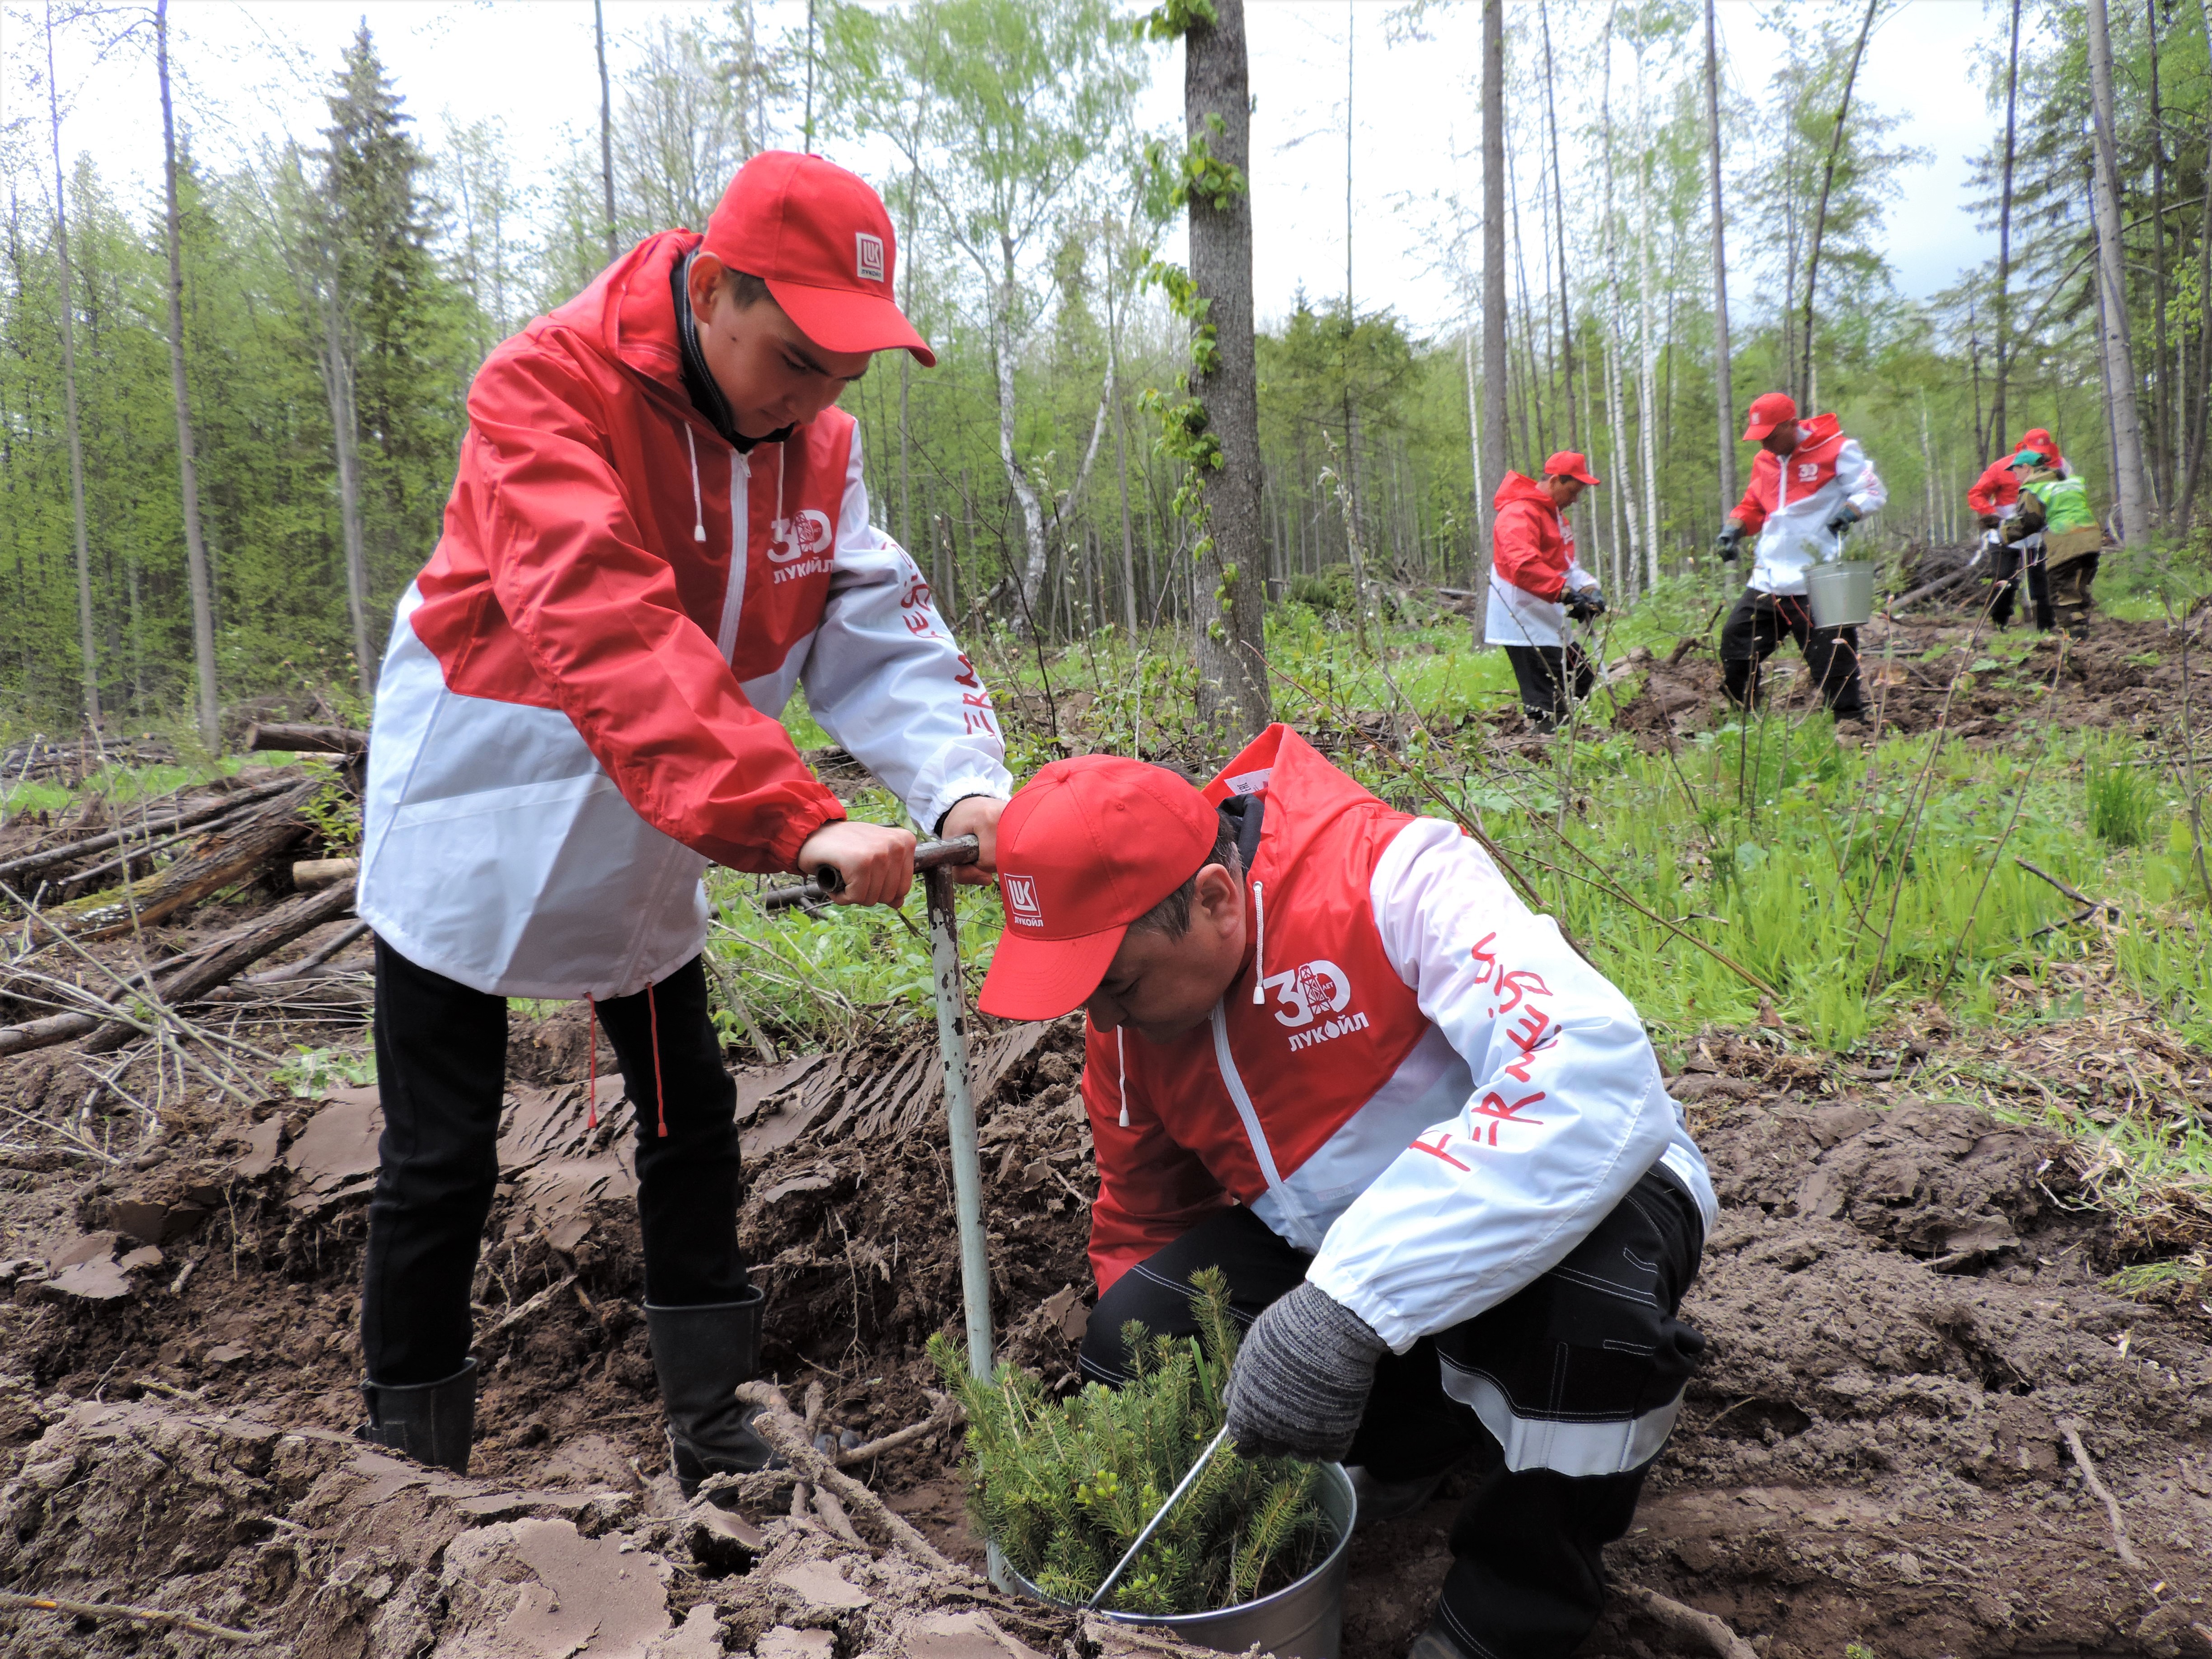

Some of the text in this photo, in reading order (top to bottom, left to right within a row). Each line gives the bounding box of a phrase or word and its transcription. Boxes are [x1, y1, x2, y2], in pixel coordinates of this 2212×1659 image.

[767, 509, 832, 562] 30
[1015, 916, 1044, 927] ЛУКОЙЛ
[1263, 960, 1350, 1027] 30
[1288, 1012, 1369, 1052] ЛУКОЙЛ
